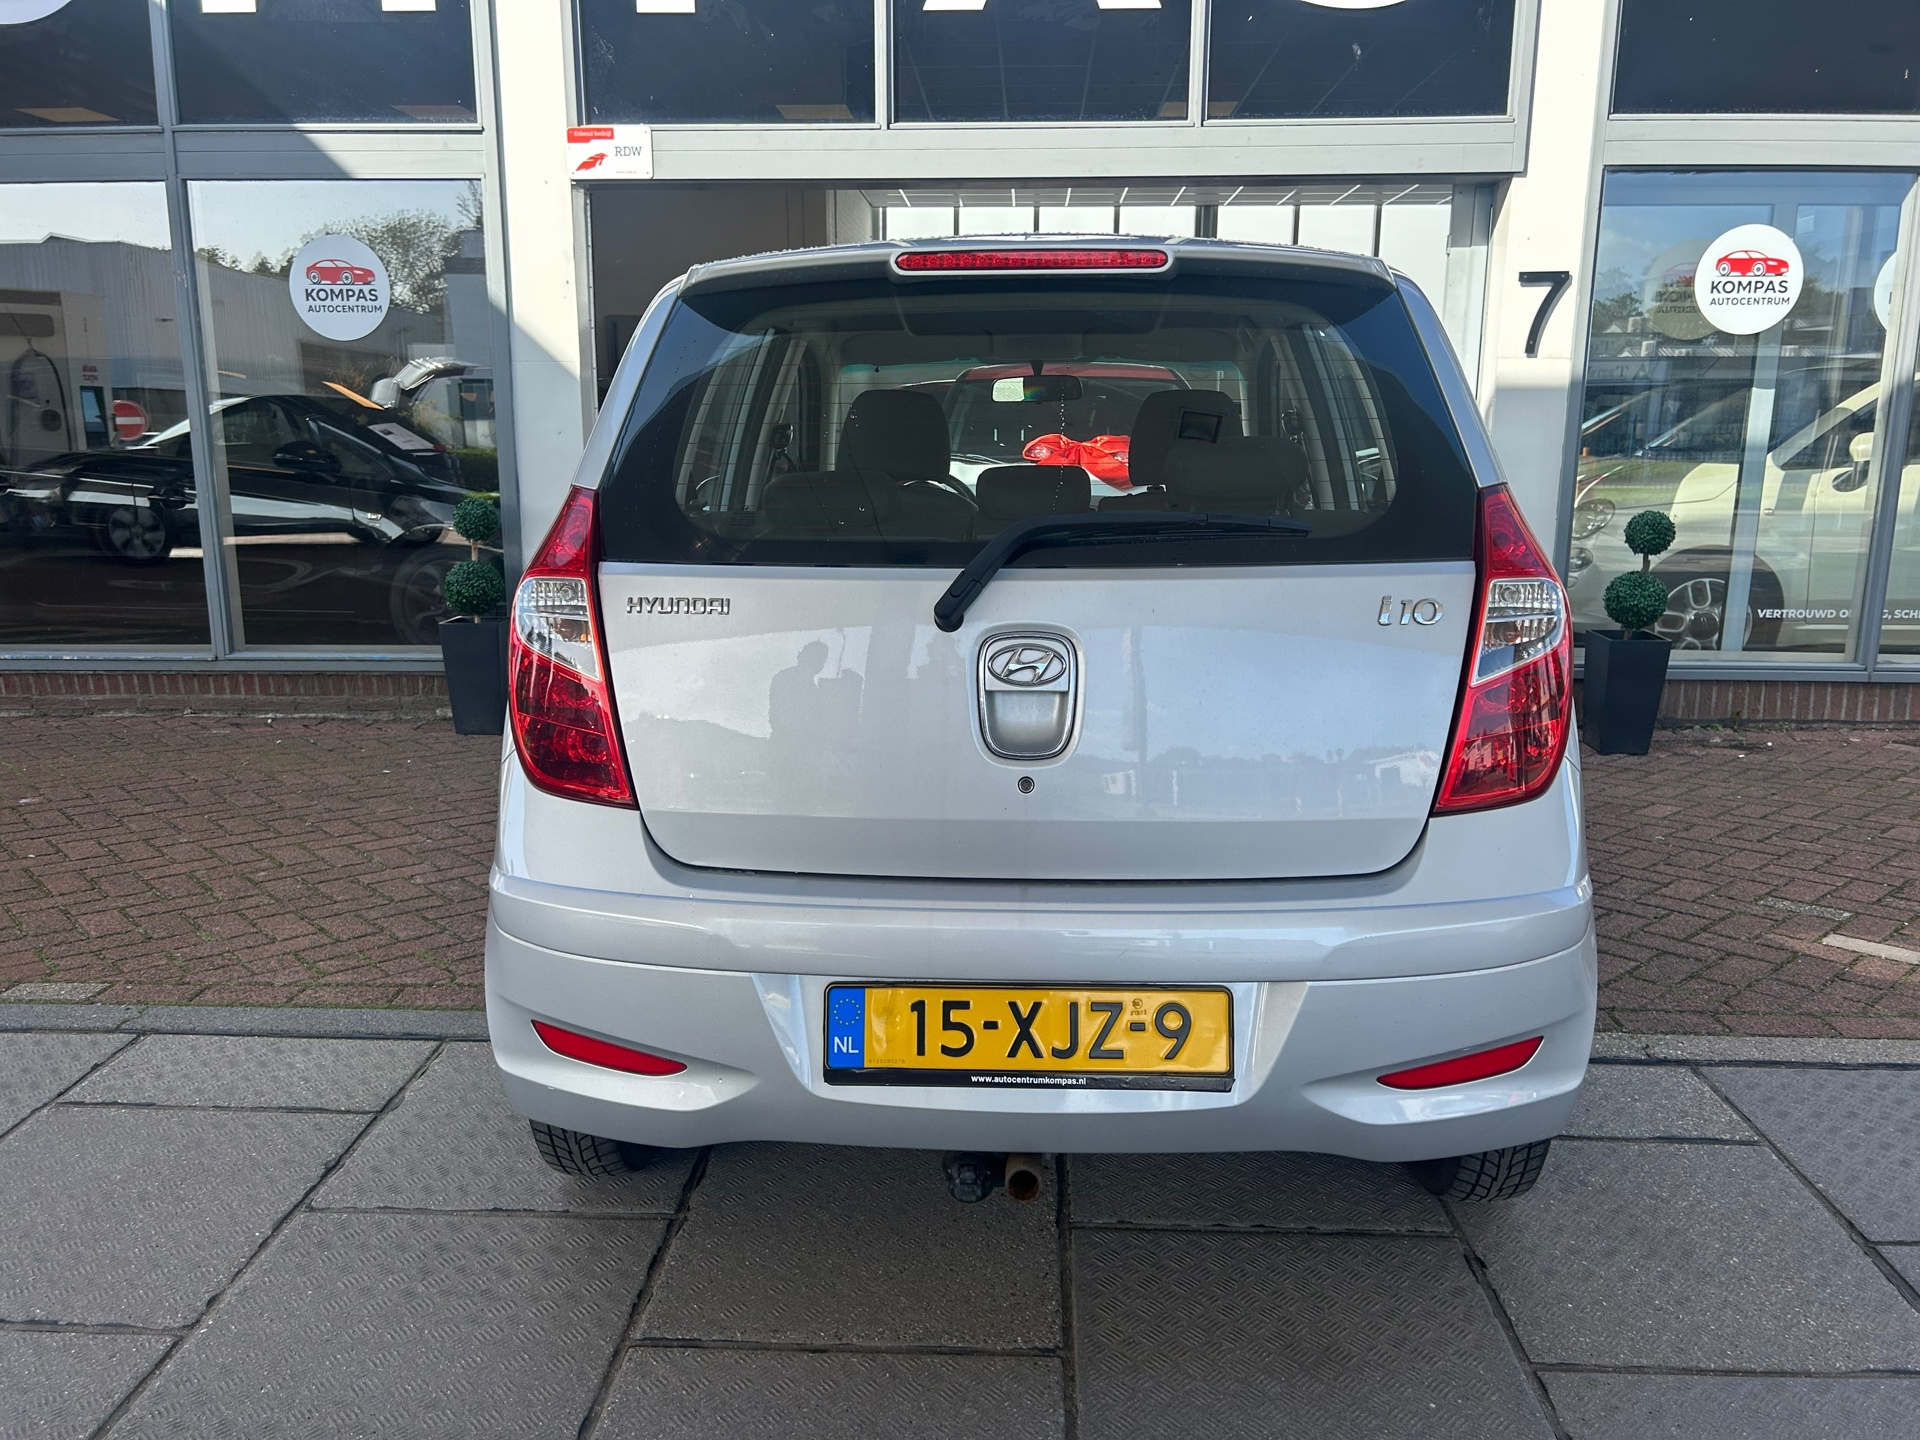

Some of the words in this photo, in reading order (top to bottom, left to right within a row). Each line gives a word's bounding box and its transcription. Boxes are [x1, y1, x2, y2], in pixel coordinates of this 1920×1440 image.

[614, 146, 642, 157] RDW
[1710, 280, 1788, 294] KOMPAS
[304, 288, 379, 301] KOMPAS
[1709, 296, 1790, 306] AUTOCENTRUM
[307, 304, 383, 313] AUTOCENTRUM
[1518, 271, 1570, 356] 7
[626, 597, 731, 615] HYUNDAI
[1757, 608, 1836, 619] VERTROUWD
[1893, 609, 1920, 619] SCH
[910, 999, 1192, 1060] 15-XJZ-9
[833, 1036, 859, 1054] NL
[970, 1075, 1087, 1087] www.autocentrumkompas.nl
